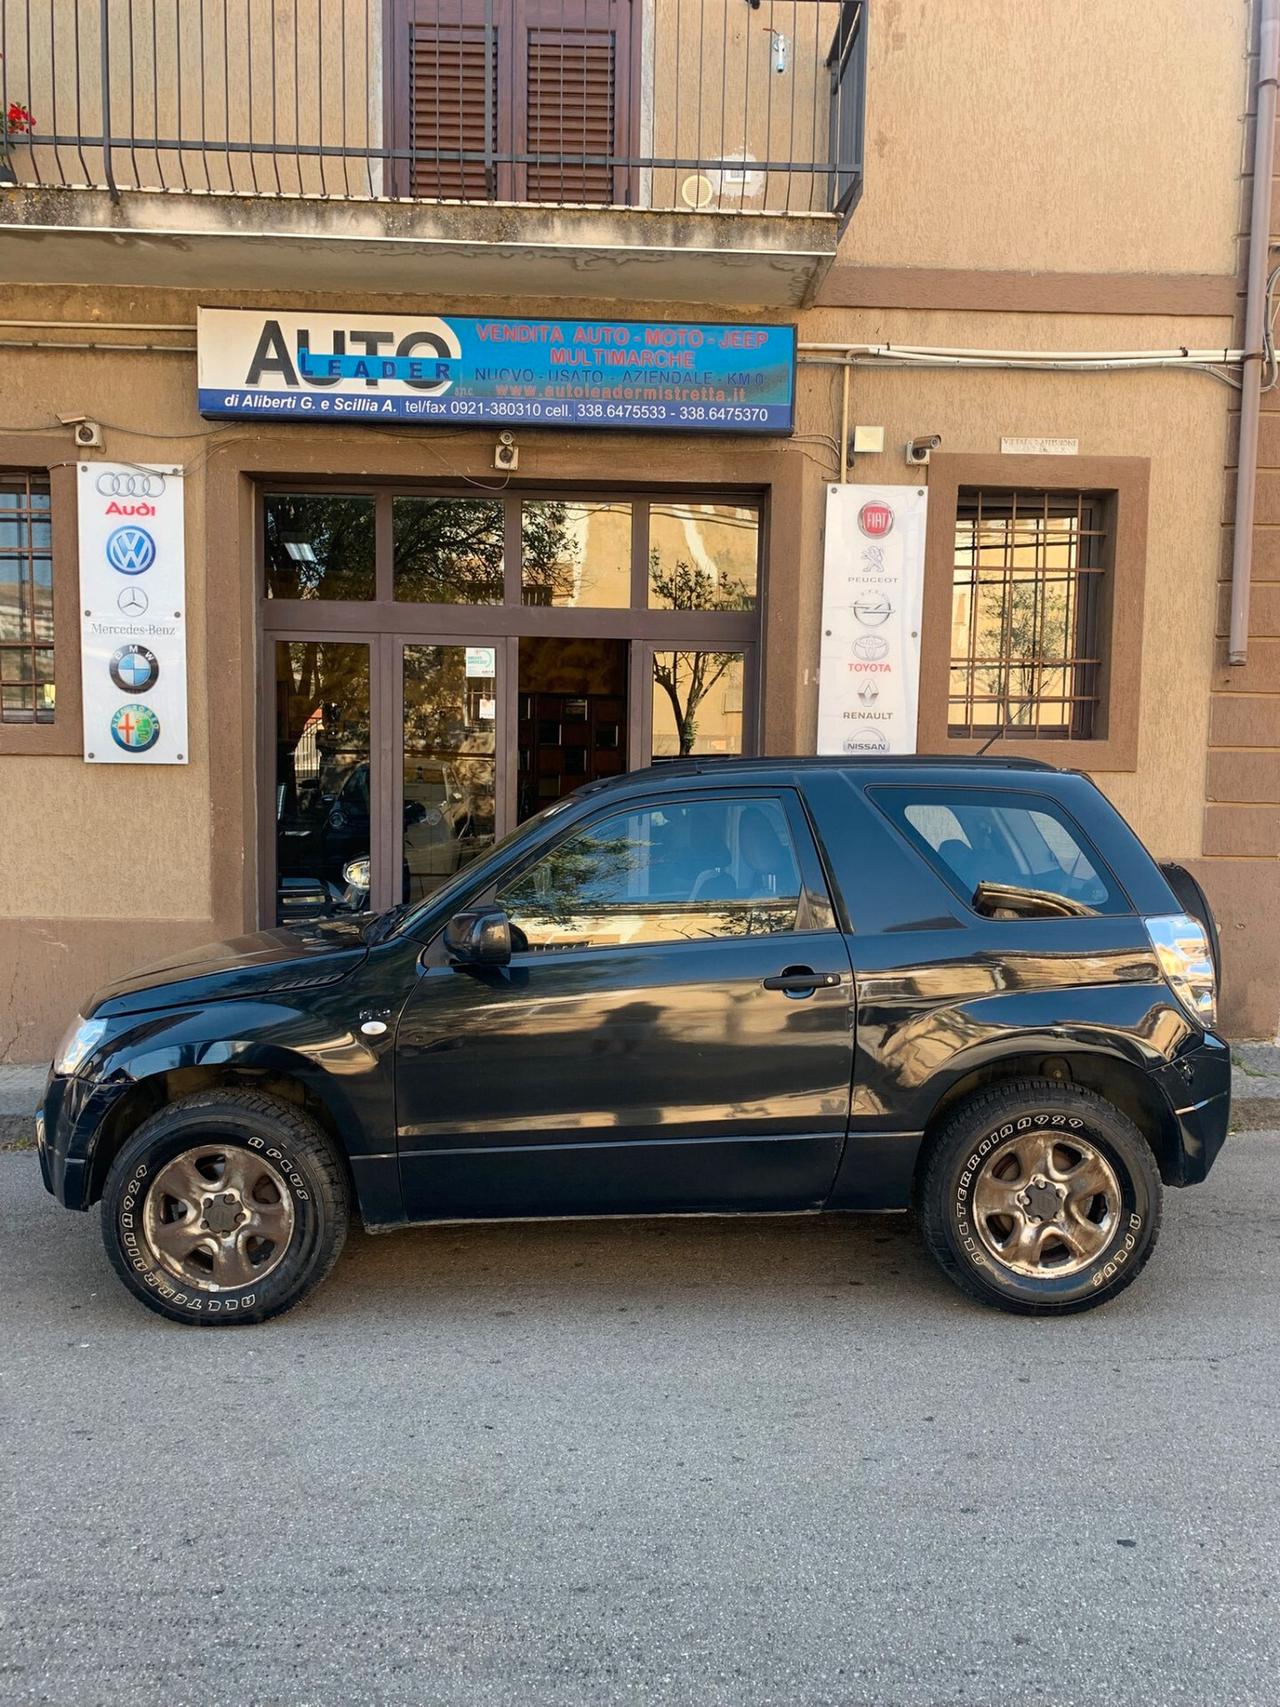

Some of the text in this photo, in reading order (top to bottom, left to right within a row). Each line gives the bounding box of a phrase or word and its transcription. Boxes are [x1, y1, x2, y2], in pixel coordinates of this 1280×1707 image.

[476, 323, 564, 344] VENDITA
[574, 326, 630, 346] AUTO
[645, 328, 704, 347] MOTO
[719, 330, 769, 349] JEEP
[245, 320, 452, 388] AUTO
[551, 348, 696, 369] MULTIMARCHE
[301, 352, 452, 380] LEADER
[475, 367, 534, 382] NUOVO
[549, 368, 604, 383] USATO
[622, 370, 713, 385] AZIENDALE
[224, 394, 239, 407] di
[242, 394, 297, 409] Aliberti
[300, 396, 316, 409] G.
[320, 399, 329, 409] e
[334, 397, 378, 412] Scillia
[381, 399, 397, 413] A.
[405, 400, 447, 414] tel/fax
[450, 401, 541, 416] 0921-380310
[545, 404, 572, 417] cell.
[577, 403, 666, 419] 338.6475533
[679, 406, 768, 422] 338.6475370
[105, 501, 156, 516] Audi
[866, 511, 888, 529] FIAT
[848, 576, 898, 584] PEUGEOT
[92, 623, 176, 636] Mercedes-Benz
[848, 663, 892, 673] TOYOTA
[843, 711, 893, 720] RENAULT
